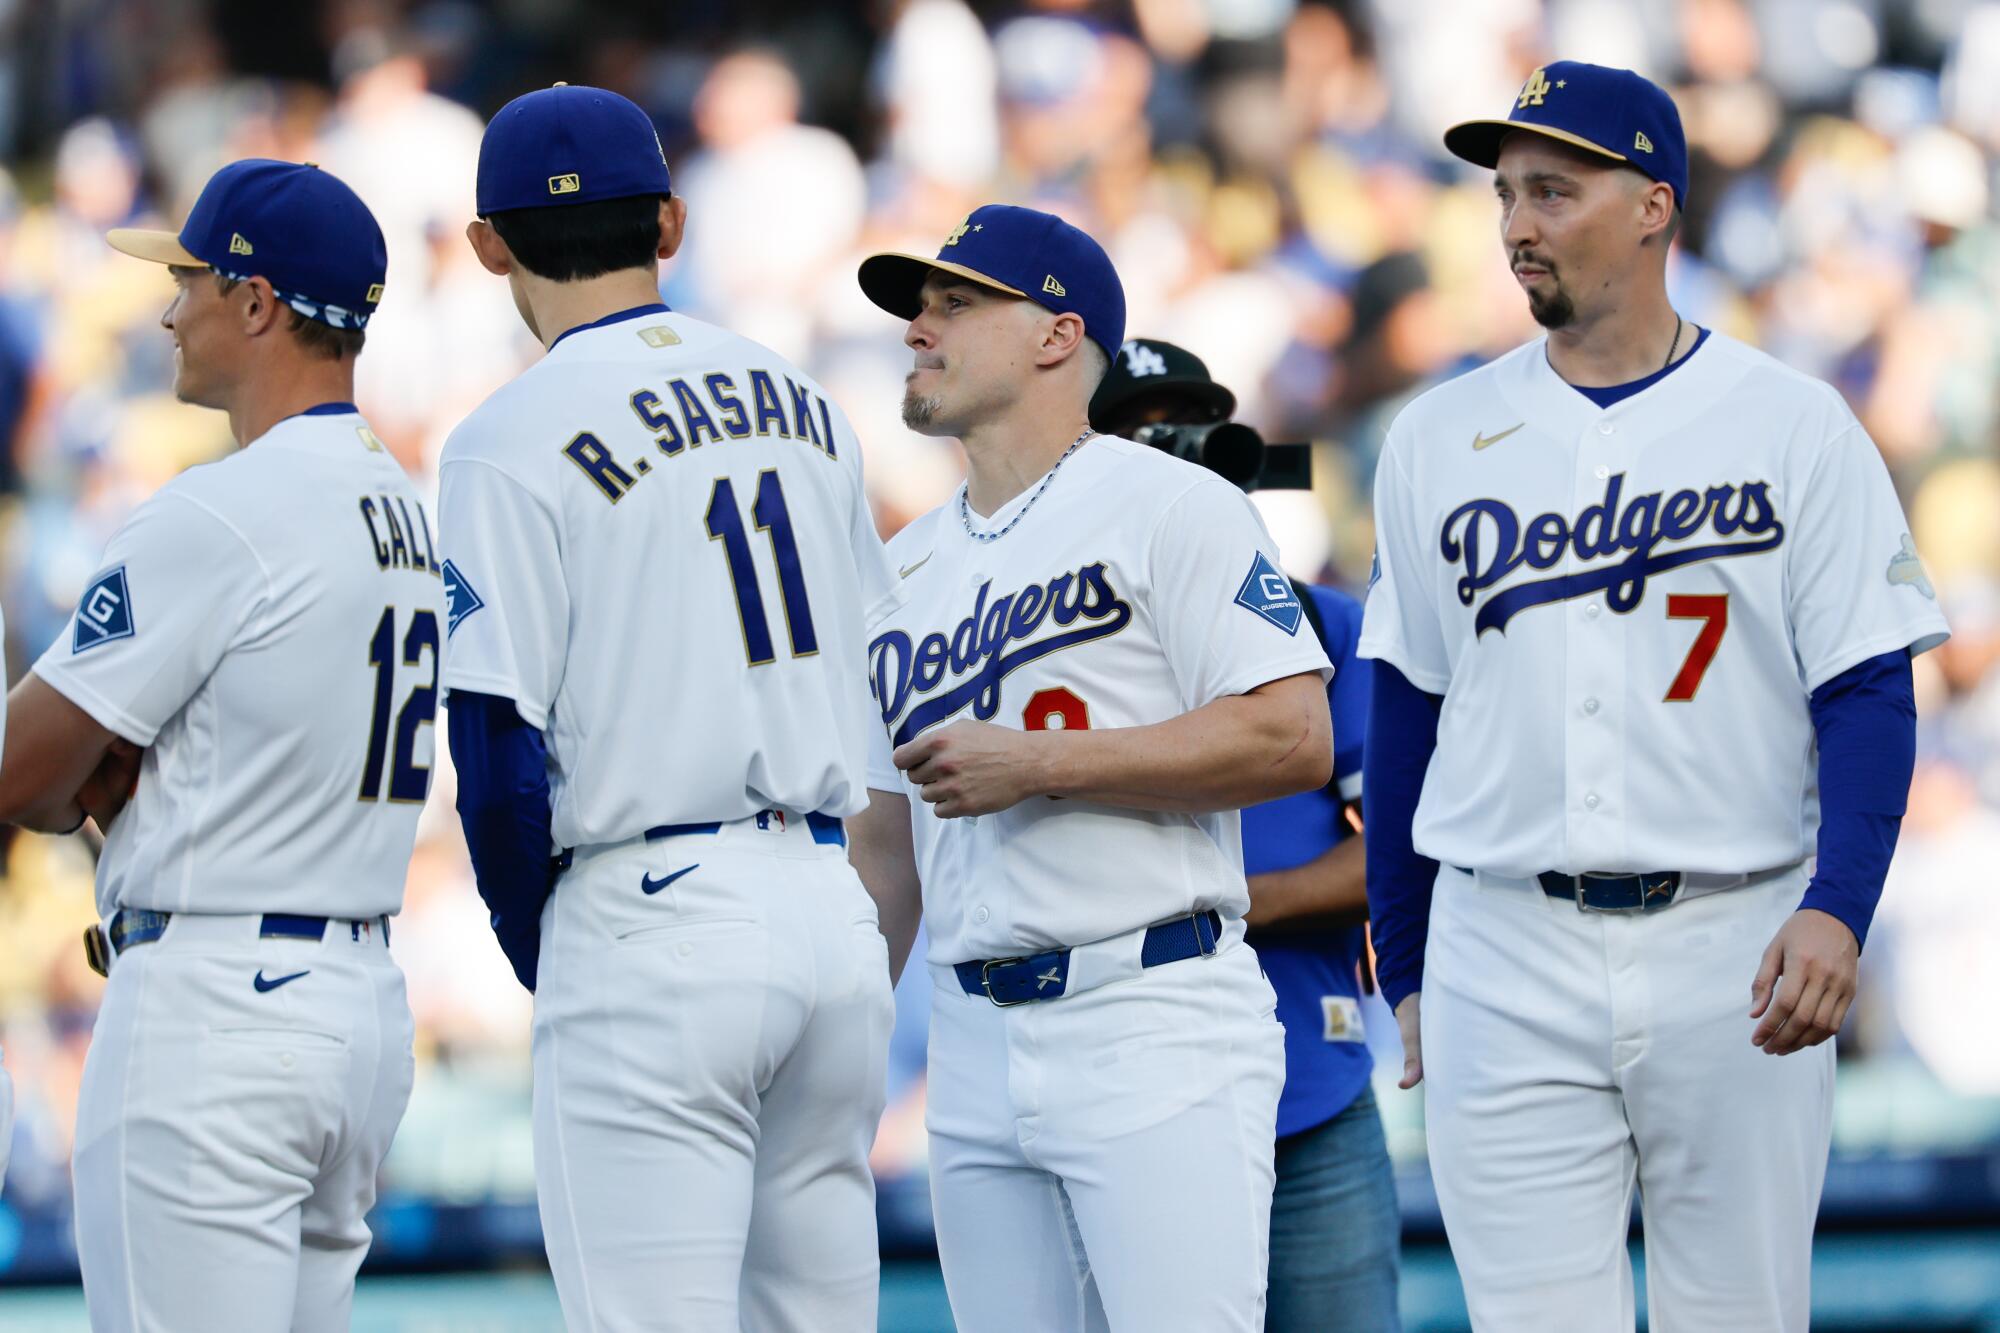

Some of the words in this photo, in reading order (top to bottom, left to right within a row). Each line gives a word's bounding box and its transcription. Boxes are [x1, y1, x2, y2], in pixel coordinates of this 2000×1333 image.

[1120, 340, 1167, 378] LA
[703, 466, 820, 668] 11
[1259, 573, 1288, 601] G
[1440, 471, 1785, 616] Dodgers
[358, 605, 439, 804] 12
[868, 560, 1133, 724] Dodgers
[1662, 593, 1729, 703] 7
